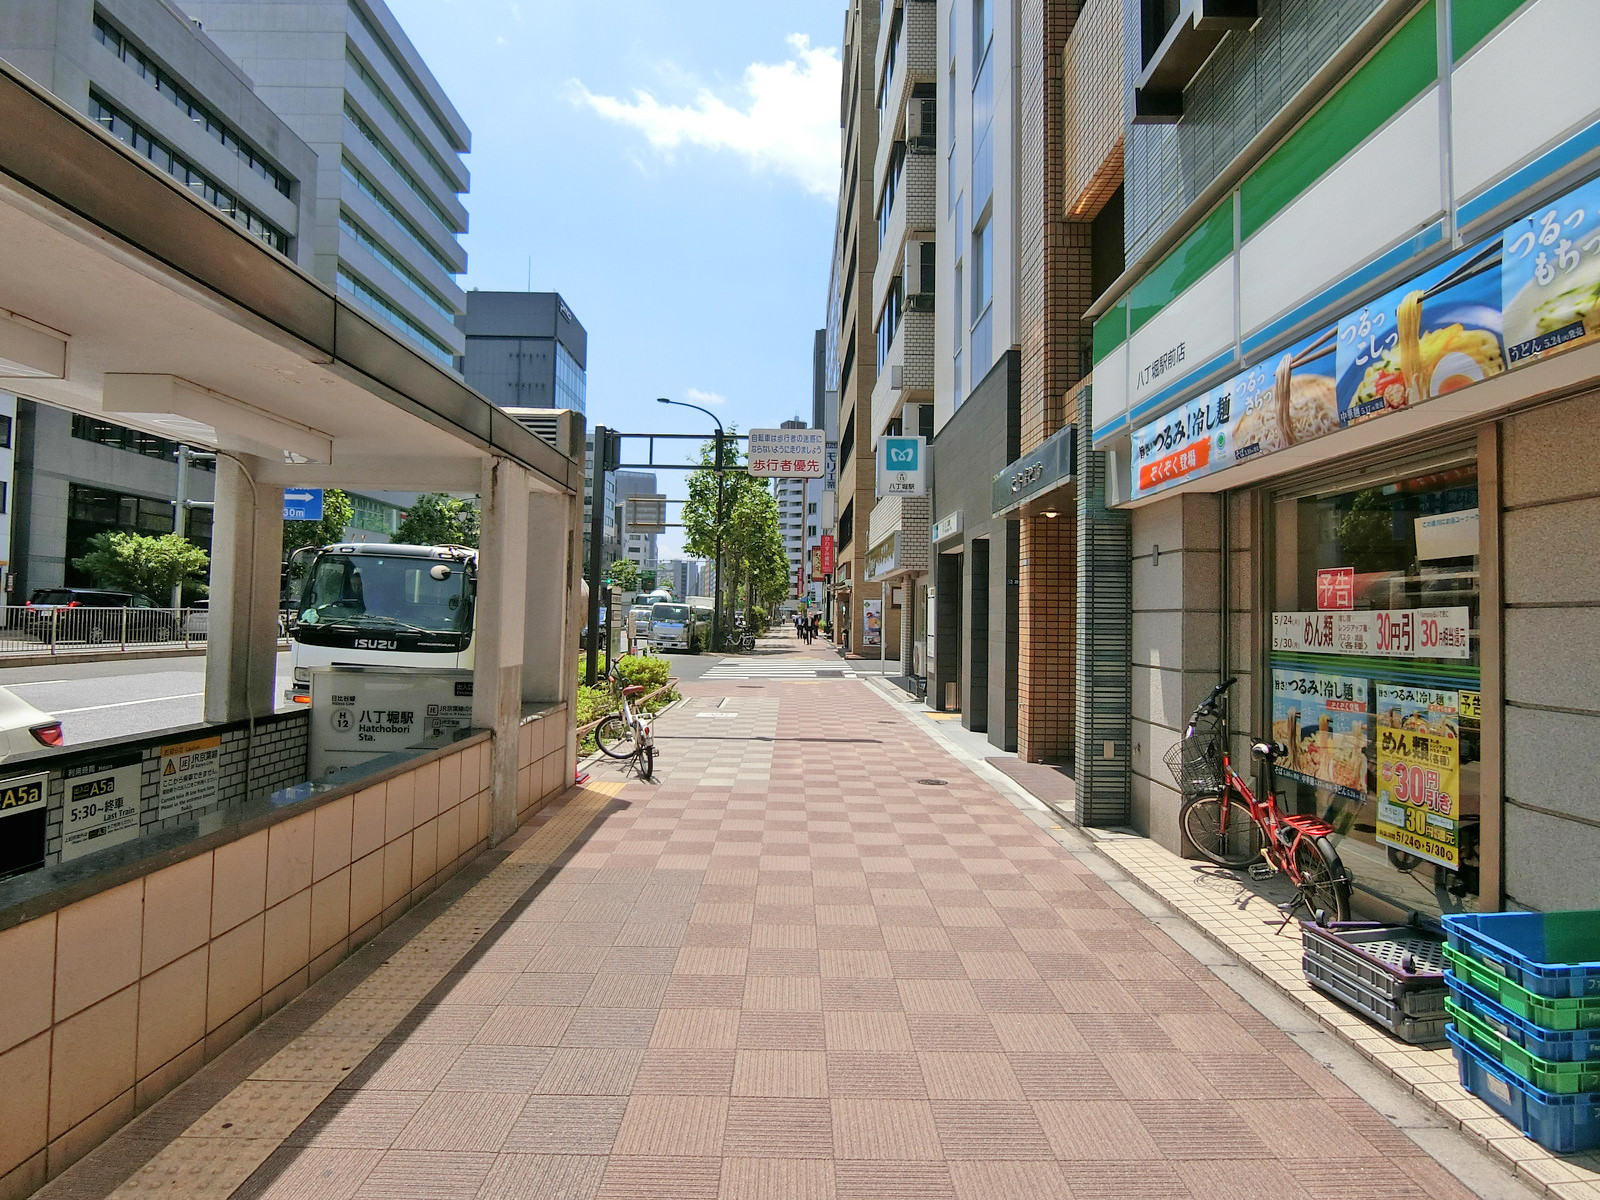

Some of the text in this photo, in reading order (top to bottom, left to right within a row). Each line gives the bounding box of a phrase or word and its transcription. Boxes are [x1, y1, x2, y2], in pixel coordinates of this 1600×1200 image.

[1508, 208, 1585, 259] つるっ
[1341, 312, 1385, 345] つるっ
[1355, 332, 1398, 366] こしっ
[1511, 343, 1541, 361] うどん
[1137, 342, 1186, 390] 八丁堀駅前店
[1236, 370, 1266, 396] つるっ
[1245, 390, 1272, 416] さらっ
[751, 445, 822, 454] ならないように走りましょう
[753, 459, 820, 472] 歩行者優先
[1150, 449, 1197, 482] ぞくぞく登場
[1319, 571, 1350, 607] 予告
[1304, 615, 1334, 647] めん類
[1376, 612, 1415, 651] 30円引
[354, 639, 397, 649] ISUZU
[359, 710, 414, 724] 八丁堀駅
[1461, 695, 1480, 716] 予告
[337, 719, 349, 728] 12
[358, 724, 410, 734] Hatchobori
[358, 733, 376, 742] Sta.
[1381, 731, 1429, 762] めん類
[2, 786, 39, 809] A5a
[90, 780, 114, 796] A5a
[103, 807, 135, 821] Last Train
